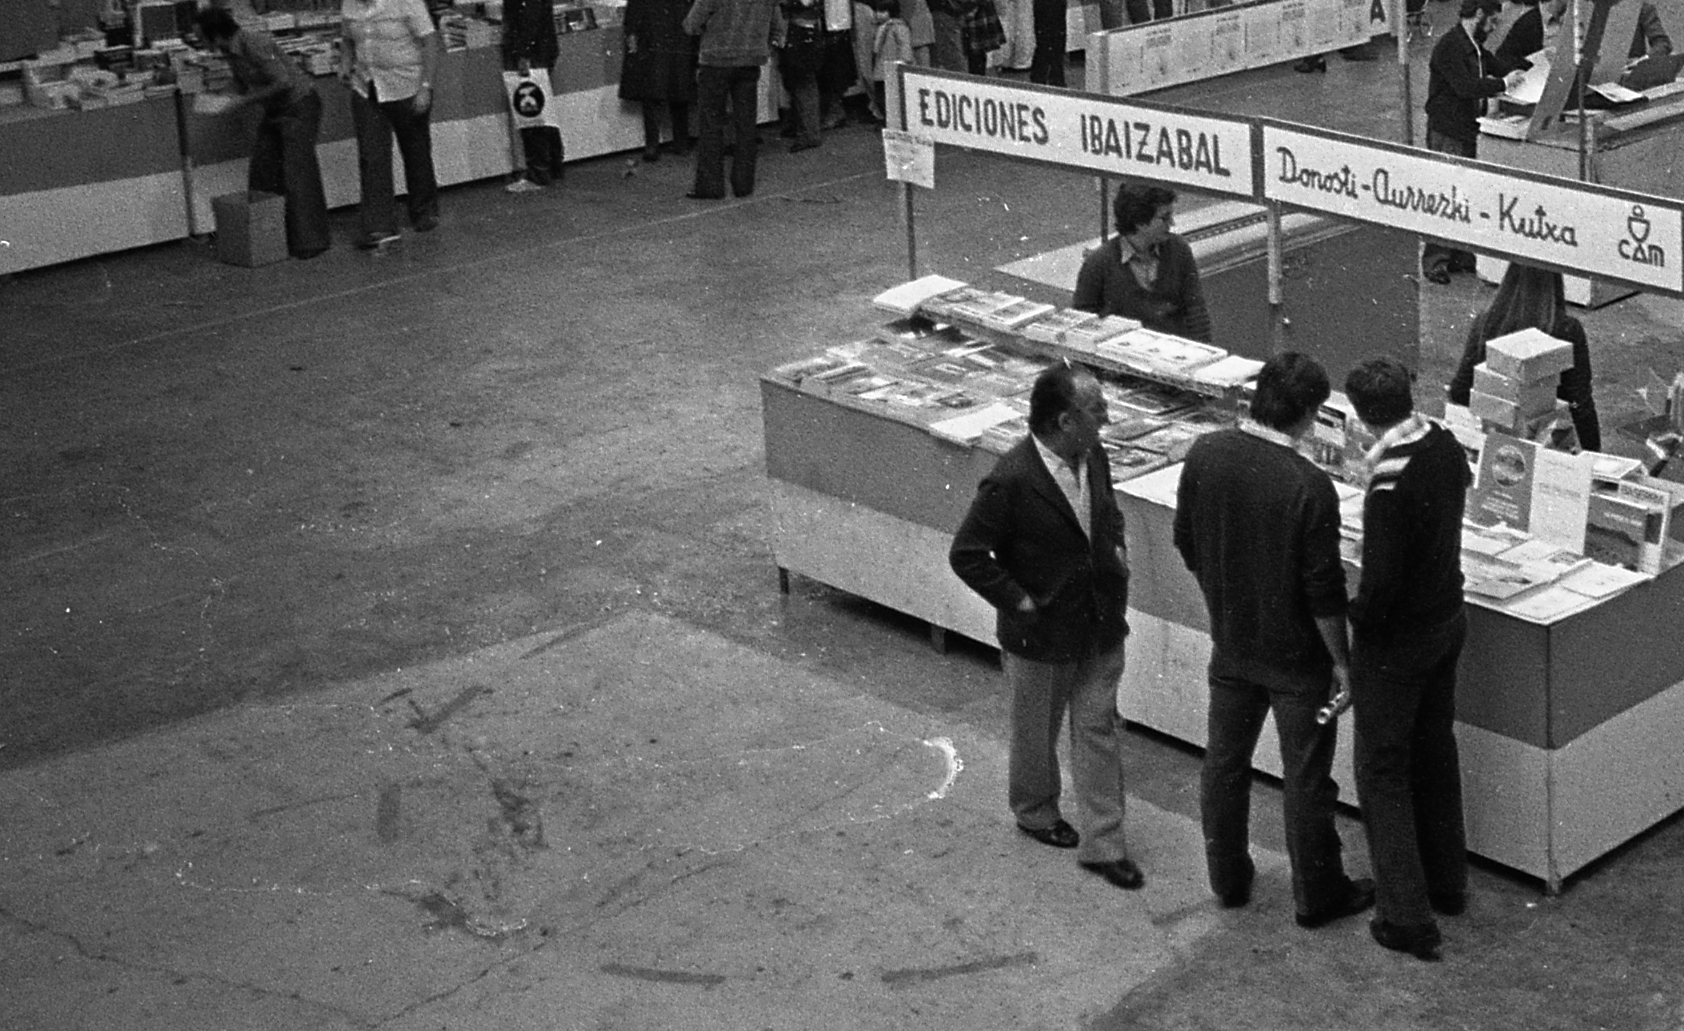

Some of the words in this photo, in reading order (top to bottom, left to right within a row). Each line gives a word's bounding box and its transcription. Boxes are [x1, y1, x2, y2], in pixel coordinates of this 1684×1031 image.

[918, 88, 1050, 146] EDICIONES
[1080, 113, 1231, 178] IBAIZABAL
[1500, 193, 1579, 247] Kutxa
